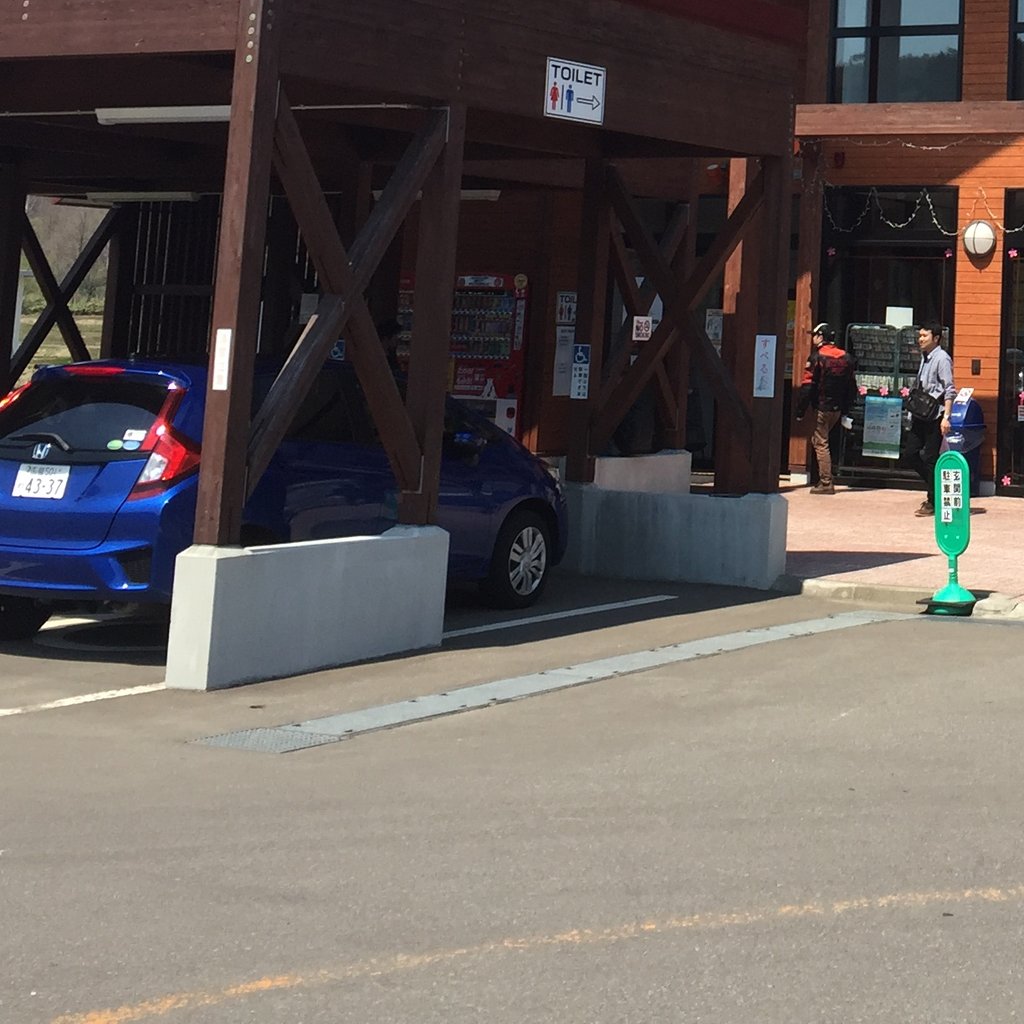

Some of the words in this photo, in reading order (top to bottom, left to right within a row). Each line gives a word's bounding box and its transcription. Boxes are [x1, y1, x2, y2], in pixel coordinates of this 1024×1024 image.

[551, 64, 602, 87] TOILET
[943, 471, 951, 520] 駐車禁止
